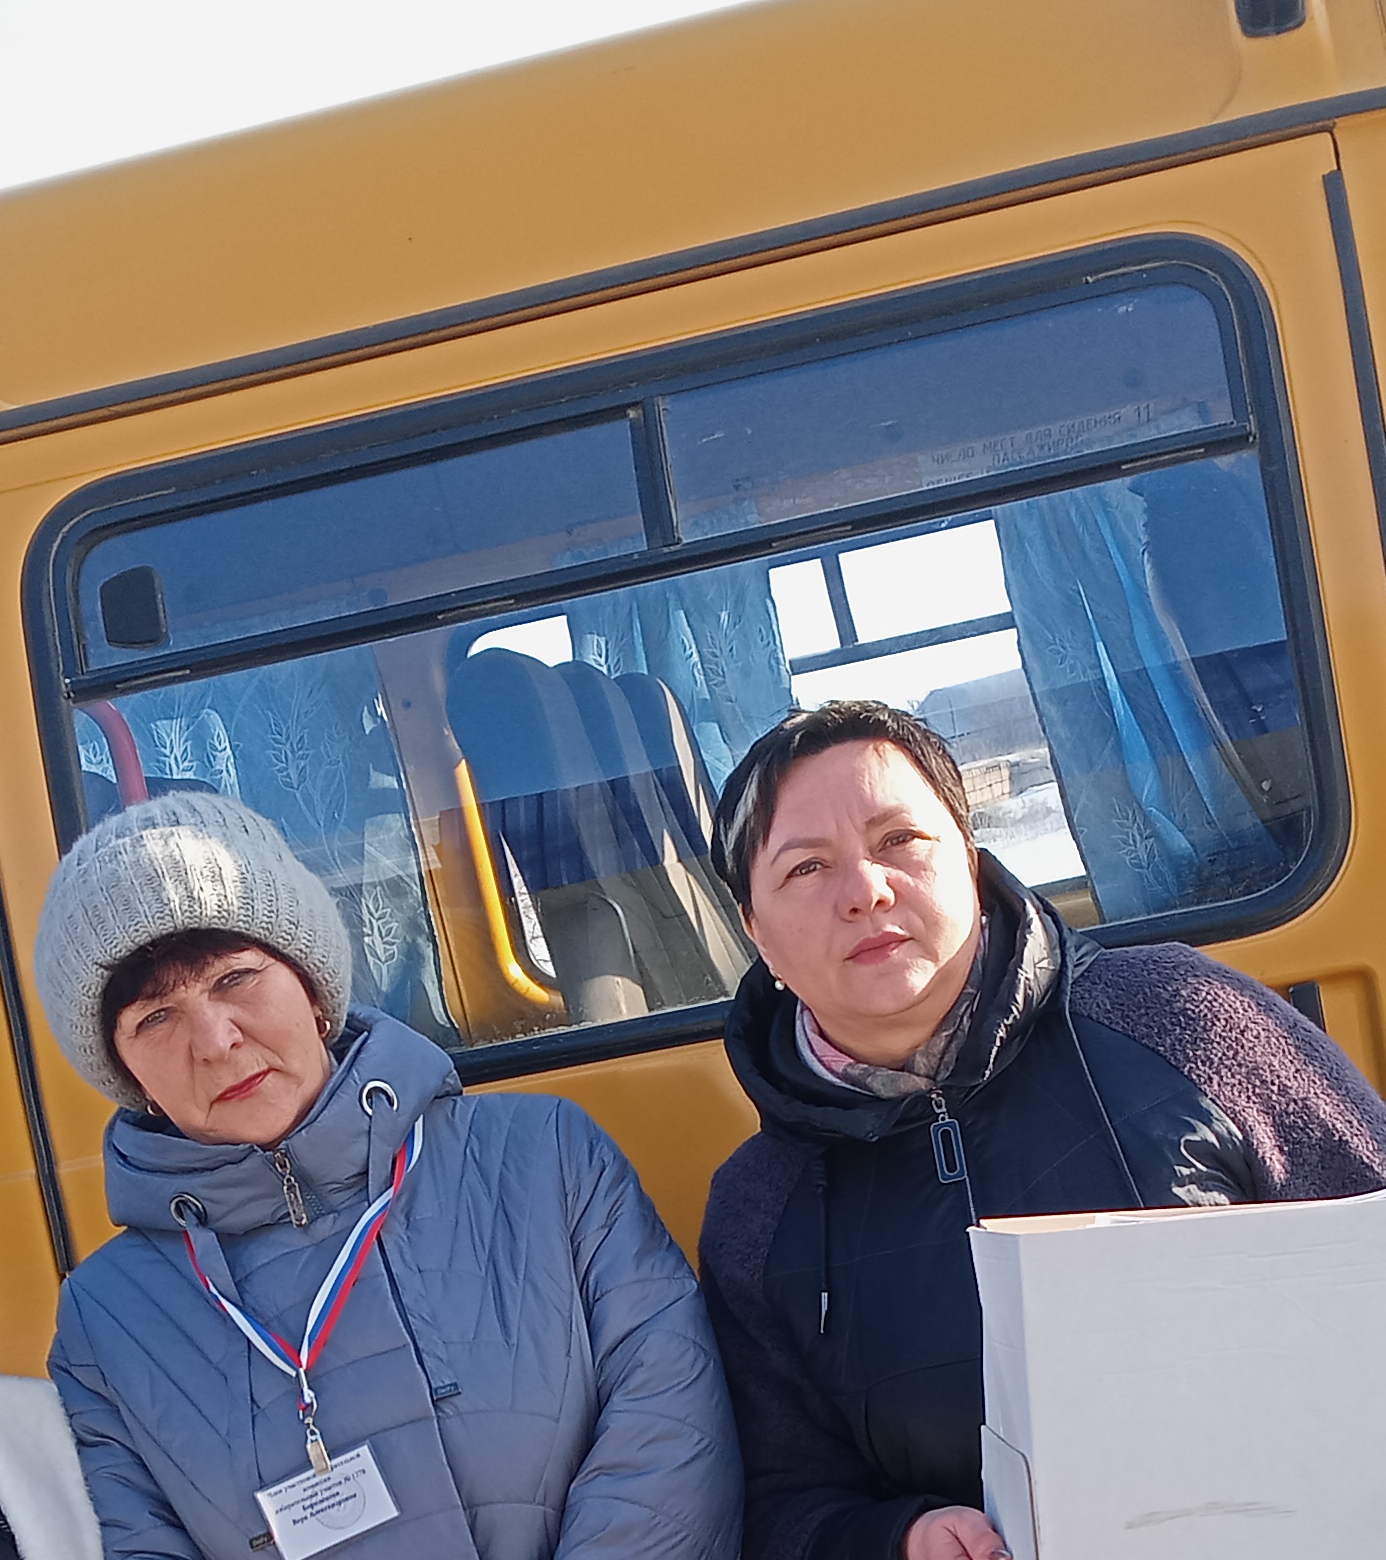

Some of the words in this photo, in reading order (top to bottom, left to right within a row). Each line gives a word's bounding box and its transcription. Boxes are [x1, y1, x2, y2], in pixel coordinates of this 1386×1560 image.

[982, 437, 1015, 455] МЕСТ
[1025, 427, 1052, 444] ДЛЯ
[1058, 409, 1122, 437] СИДЕНИЯ
